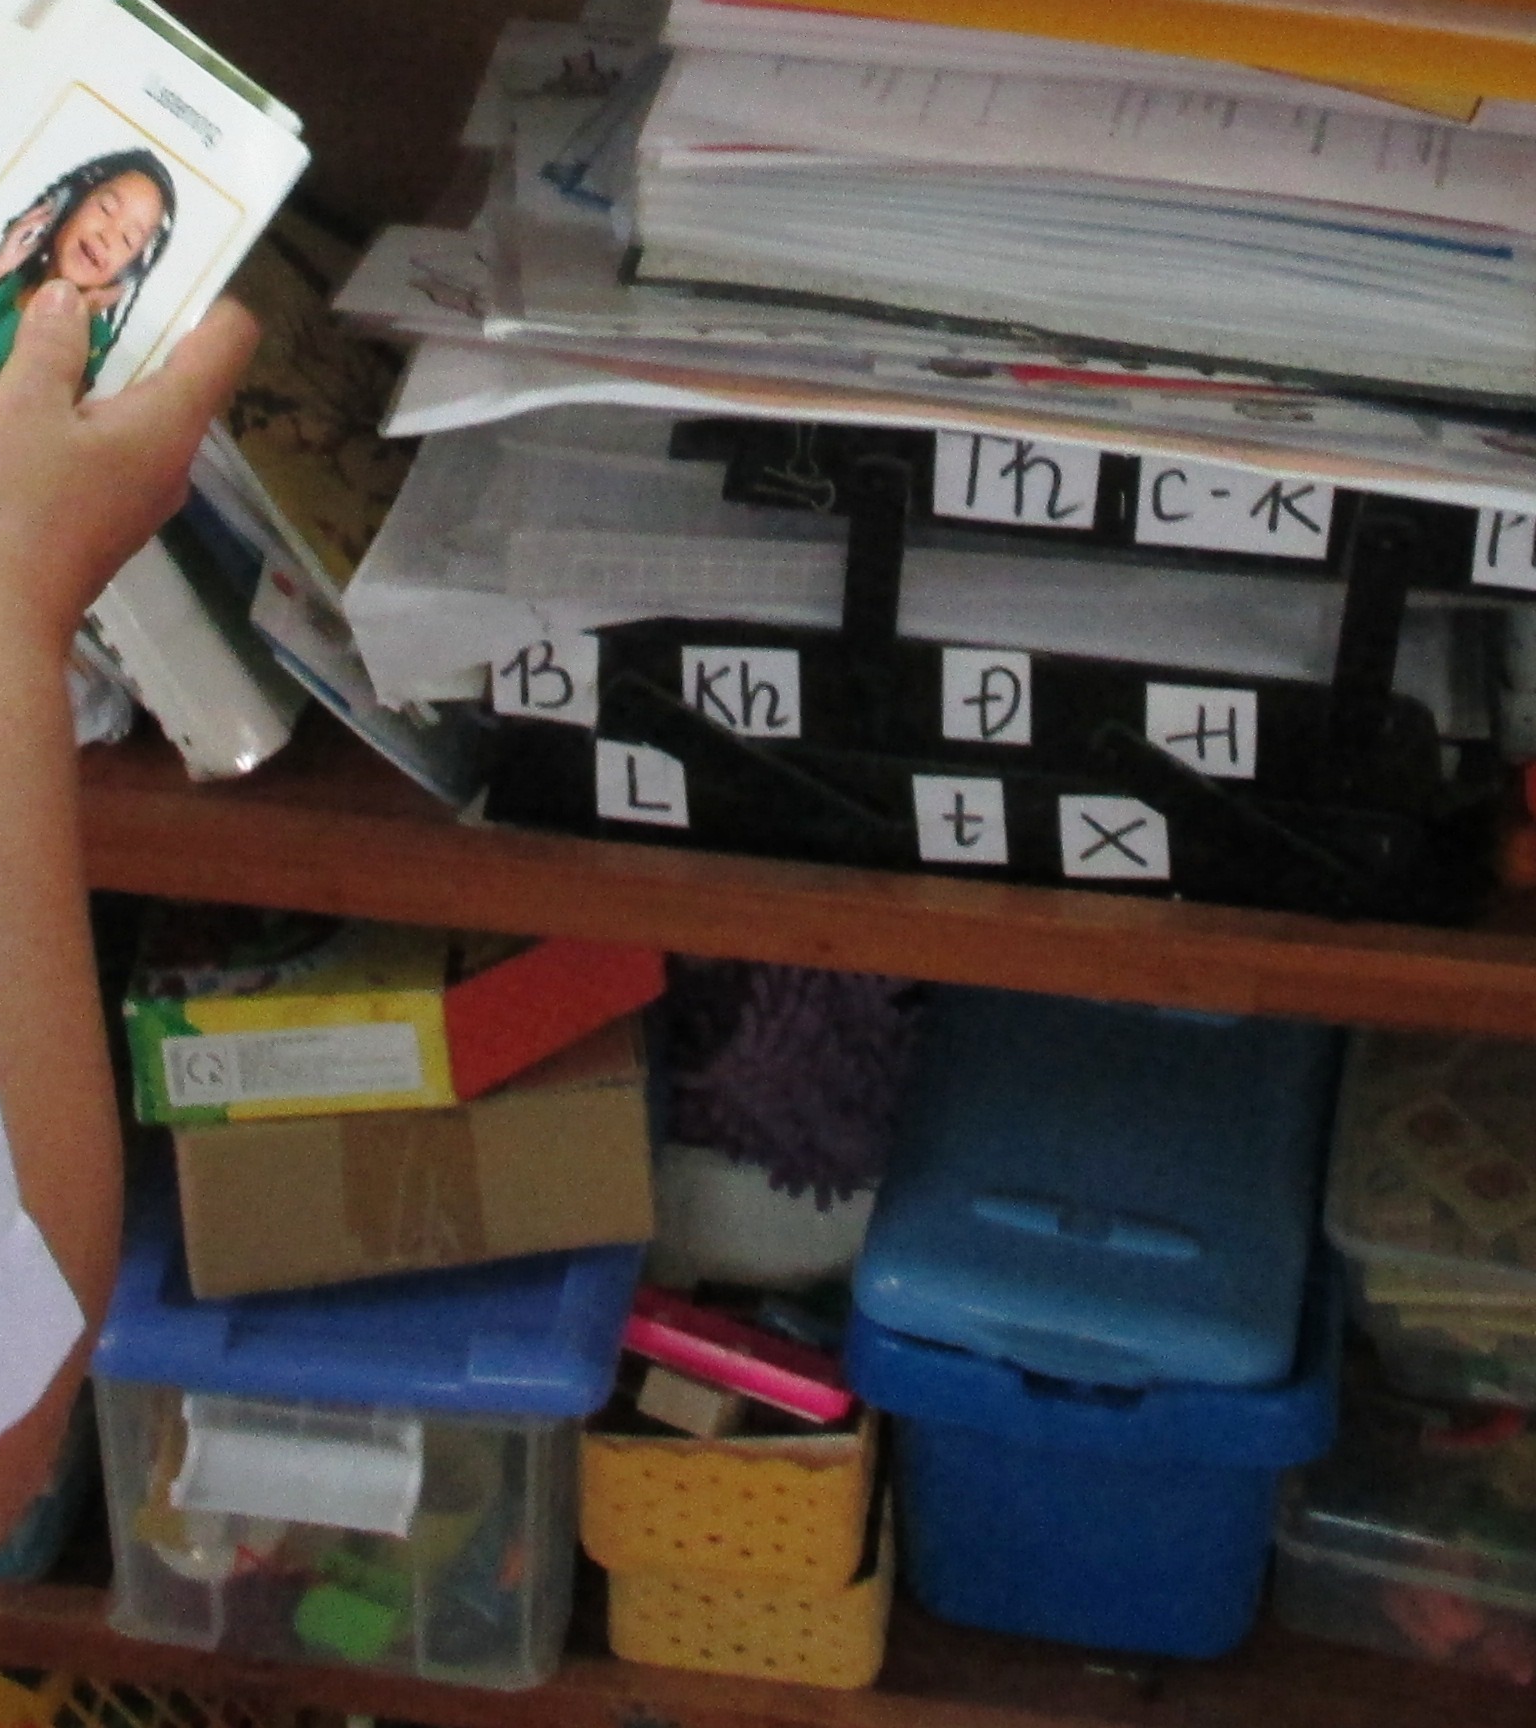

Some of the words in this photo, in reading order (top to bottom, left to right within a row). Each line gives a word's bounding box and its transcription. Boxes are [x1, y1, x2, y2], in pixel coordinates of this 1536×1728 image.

[693, 658, 790, 731] Kh
[1166, 703, 1239, 764] H
[626, 752, 672, 812] L
[941, 789, 984, 848] t
